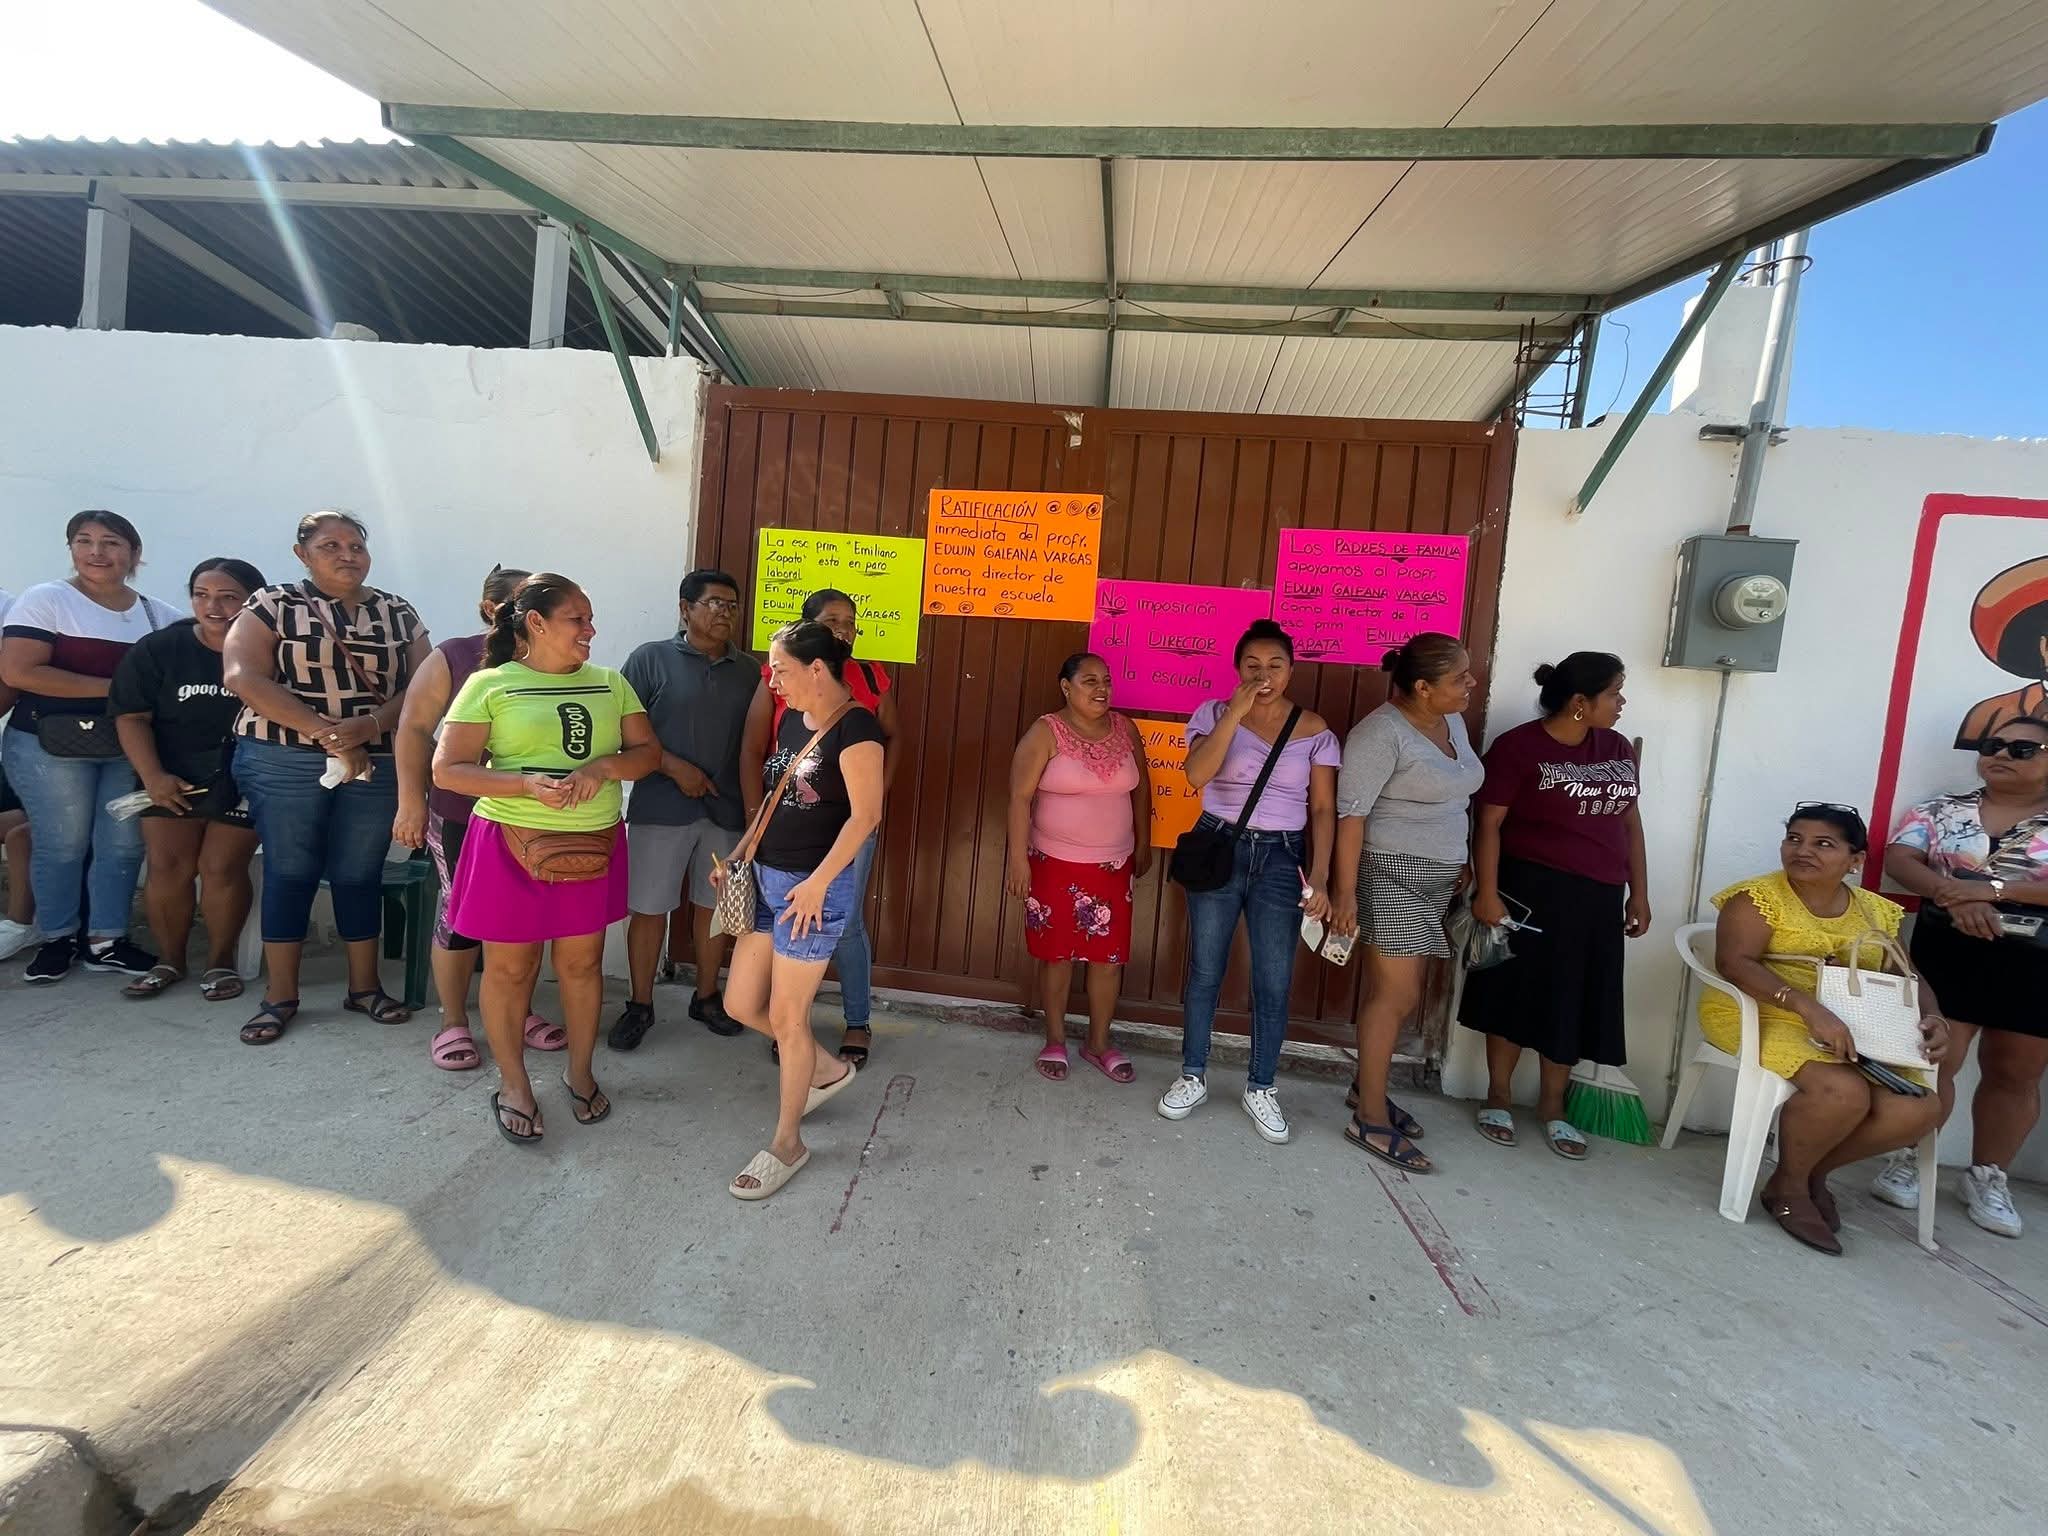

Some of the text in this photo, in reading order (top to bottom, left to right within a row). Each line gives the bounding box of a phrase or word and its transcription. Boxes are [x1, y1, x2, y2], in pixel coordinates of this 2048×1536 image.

[766, 532, 785, 547] La
[791, 539, 809, 549] esc
[935, 520, 1006, 541] inmediata
[1019, 523, 1040, 542] del
[934, 542, 976, 557] EDWIN
[1043, 551, 1092, 566] VARGAS
[1335, 537, 1386, 555] PADRES
[1393, 543, 1409, 554] DE
[1415, 544, 1462, 558] FAMILIA
[766, 566, 803, 580] laboral
[848, 560, 861, 569] en
[865, 561, 887, 575] paro
[982, 565, 1036, 582] director
[1043, 568, 1065, 585] de
[1287, 560, 1364, 578] apoyamos
[1373, 563, 1388, 577] al
[764, 583, 780, 593] En
[934, 578, 1056, 604] nuestra escuela
[1284, 580, 1324, 596] EDWIN
[1396, 589, 1448, 603] VARGAS
[763, 600, 901, 621] EDWIN VARGAS
[1331, 605, 1384, 621] director
[1391, 608, 1407, 621] de
[1414, 606, 1430, 621] la
[1280, 619, 1304, 629] esc
[1314, 620, 1344, 632] prim
[1103, 623, 1217, 650] del DIRECTOR
[1122, 655, 1212, 690] la escuela
[565, 707, 587, 754] Crayon
[1157, 785, 1199, 798] DE LA
[1563, 782, 1602, 798] New
